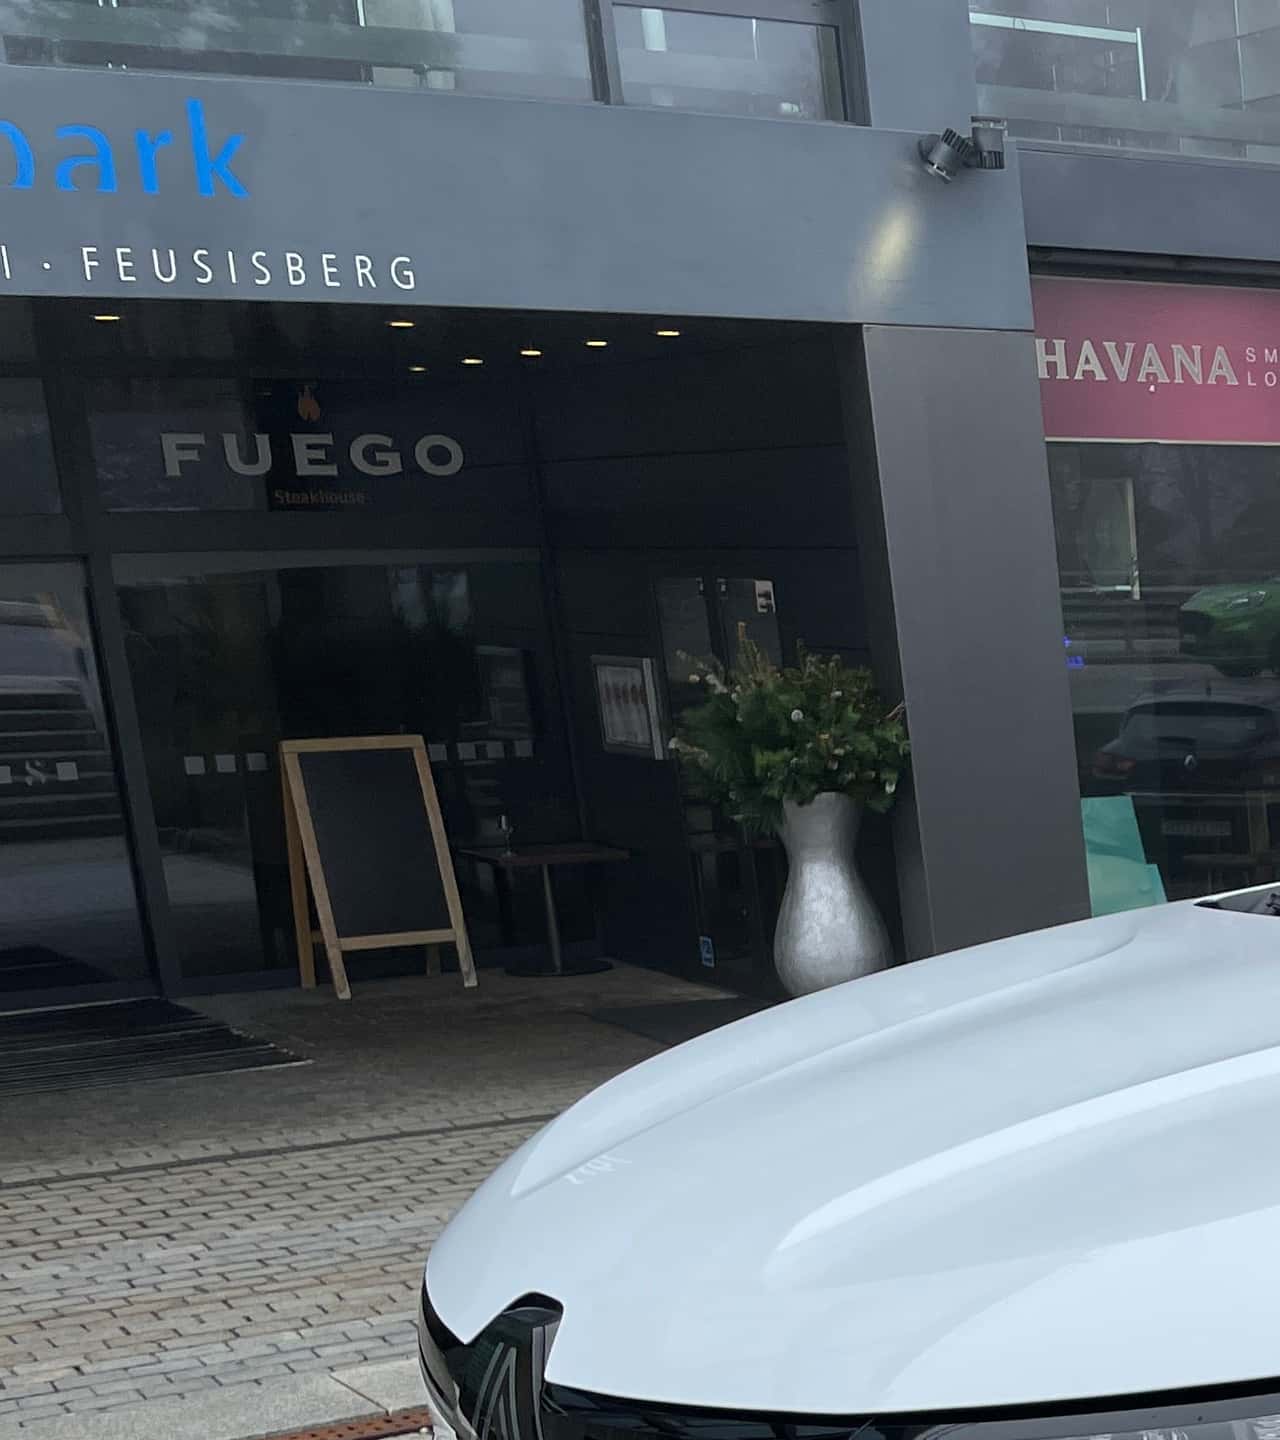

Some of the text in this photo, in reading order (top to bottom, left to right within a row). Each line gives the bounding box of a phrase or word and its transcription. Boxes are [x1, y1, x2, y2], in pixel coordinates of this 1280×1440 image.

[82, 246, 417, 290] FEUSISBERG
[1035, 337, 1239, 386] HAVANA
[159, 432, 465, 478] FUEGO
